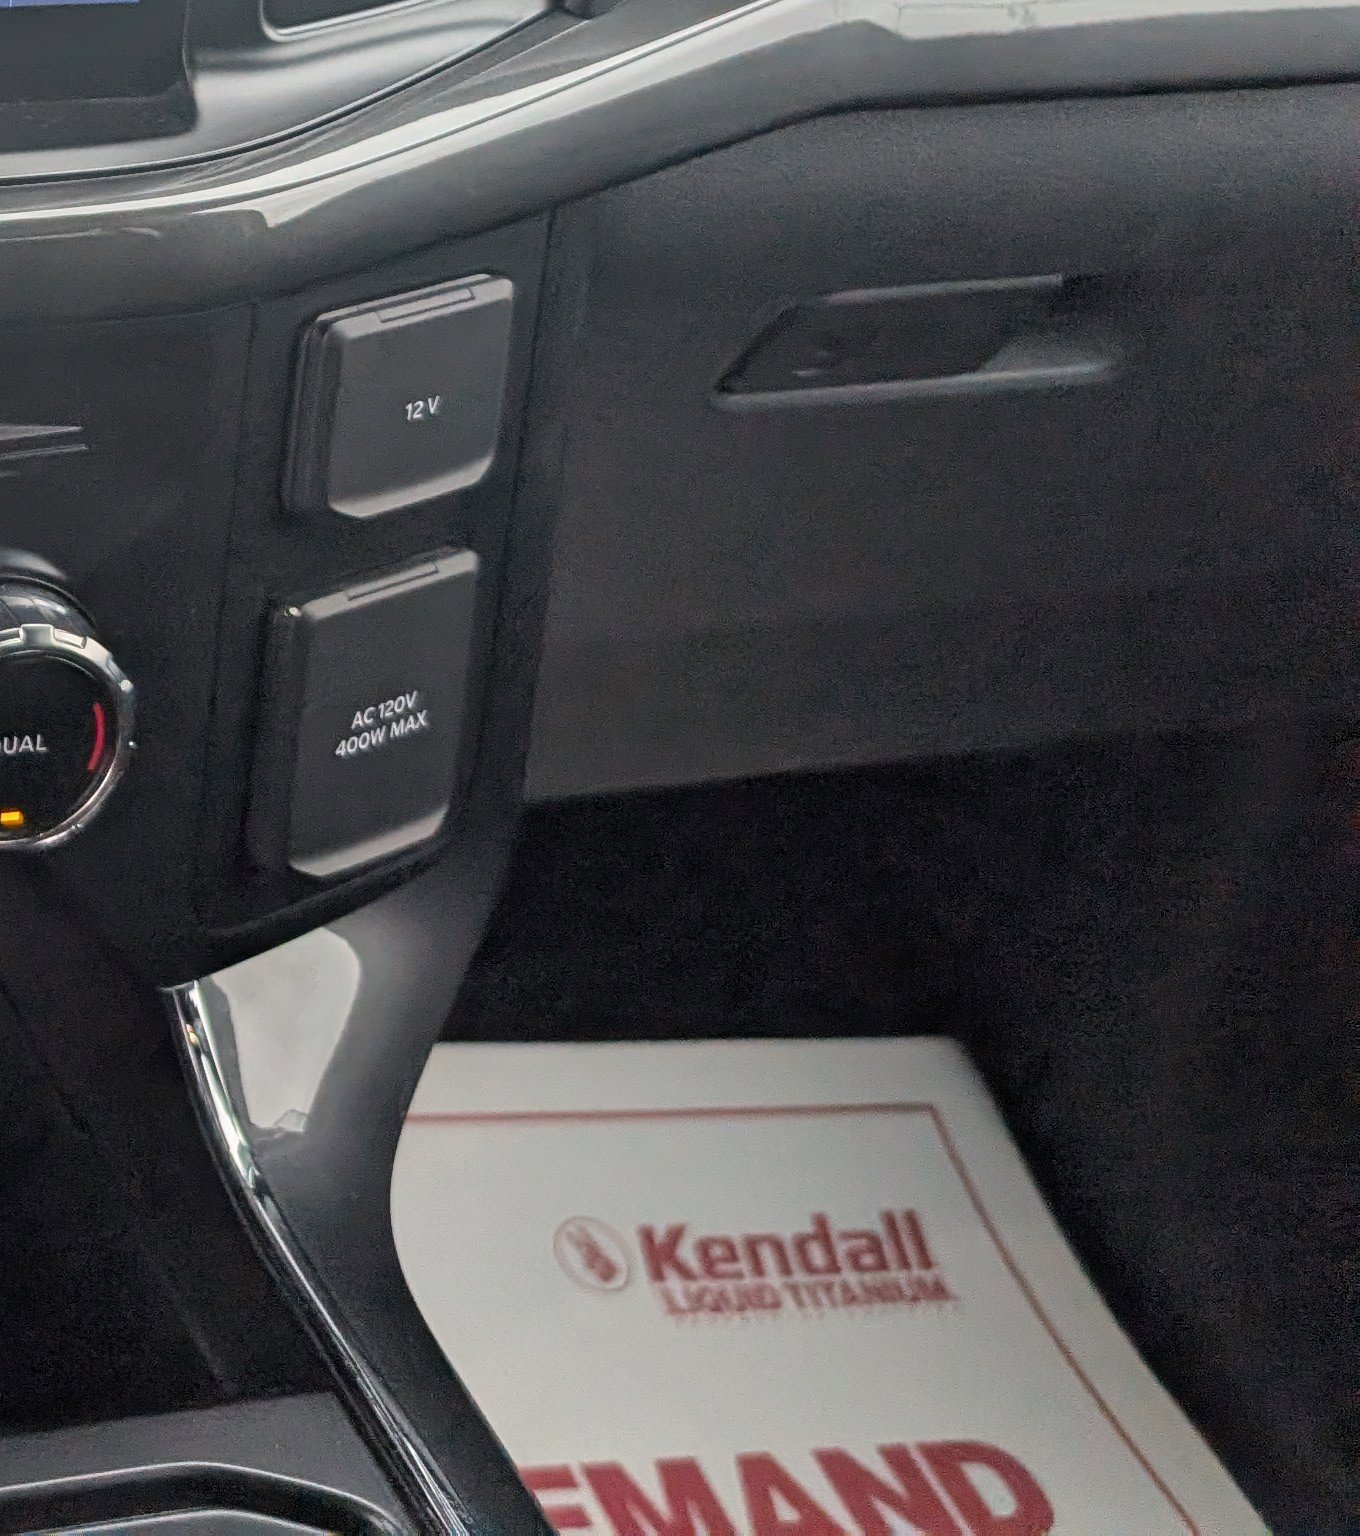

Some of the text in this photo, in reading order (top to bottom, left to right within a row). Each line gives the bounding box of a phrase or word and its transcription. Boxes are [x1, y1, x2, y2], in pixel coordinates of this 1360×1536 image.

[405, 395, 441, 421] 12 V
[350, 690, 419, 729] AC 120V
[335, 710, 429, 758] 400W MAX
[637, 1207, 935, 1283] Kendall
[658, 1272, 956, 1317] LIQUID TITANIUM
